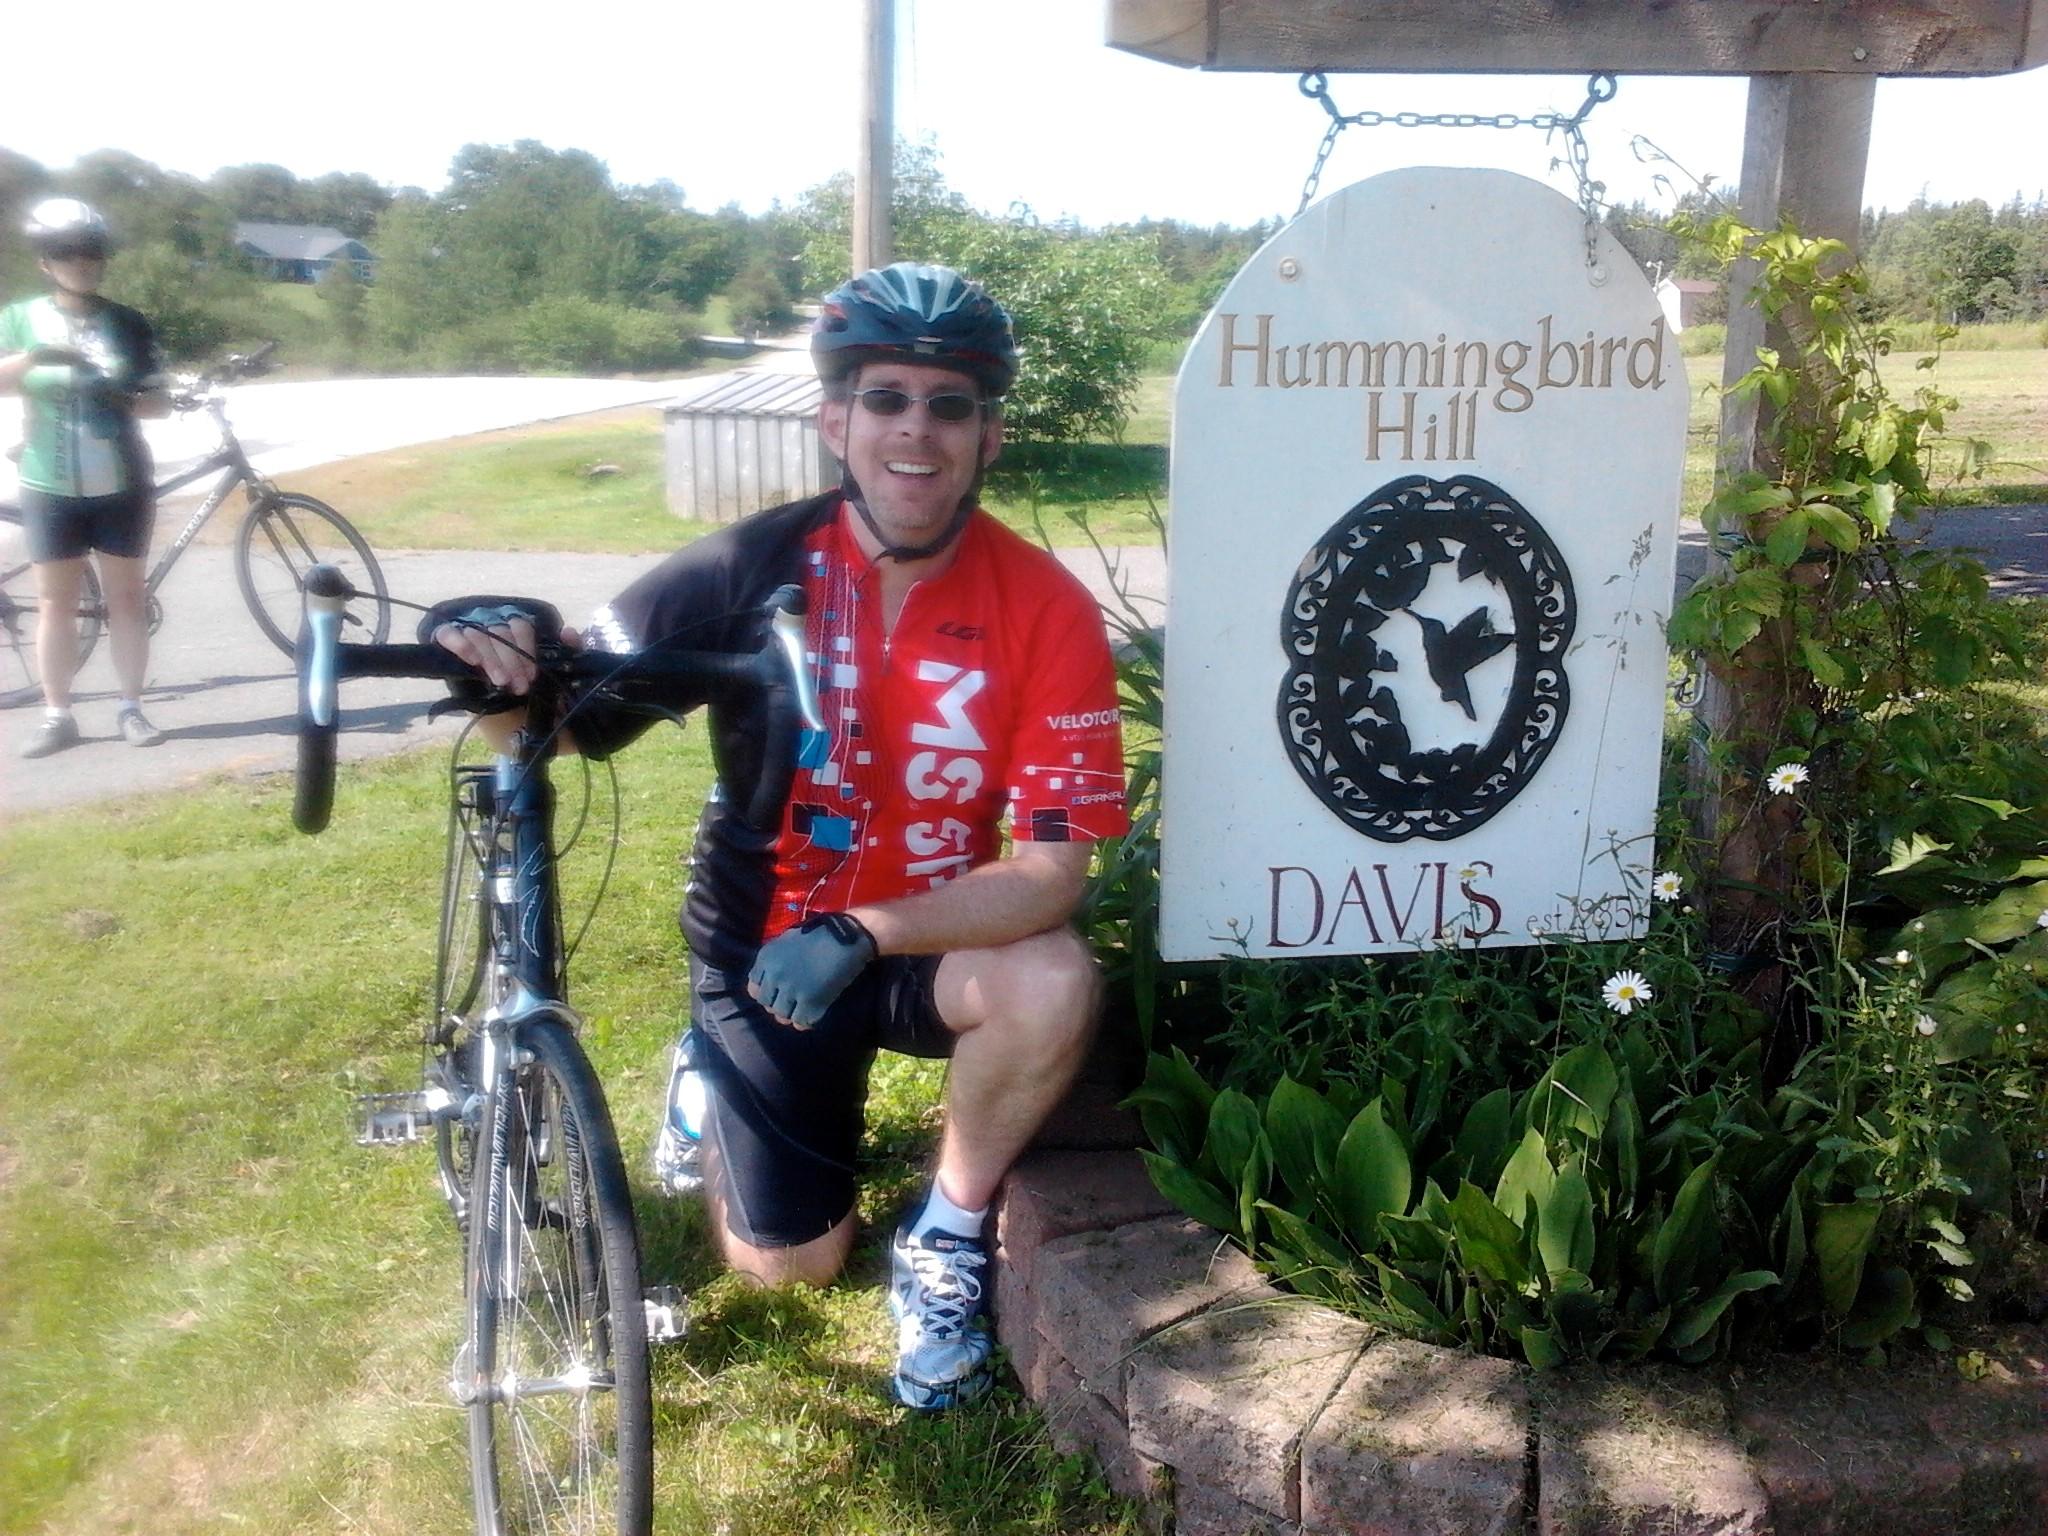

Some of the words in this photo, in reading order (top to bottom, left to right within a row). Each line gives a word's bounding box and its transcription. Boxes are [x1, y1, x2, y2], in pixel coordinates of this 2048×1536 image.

[1217, 313, 1667, 413] Hummingbird
[1365, 390, 1480, 461] Hill
[1266, 861, 1502, 948] DAVIS
